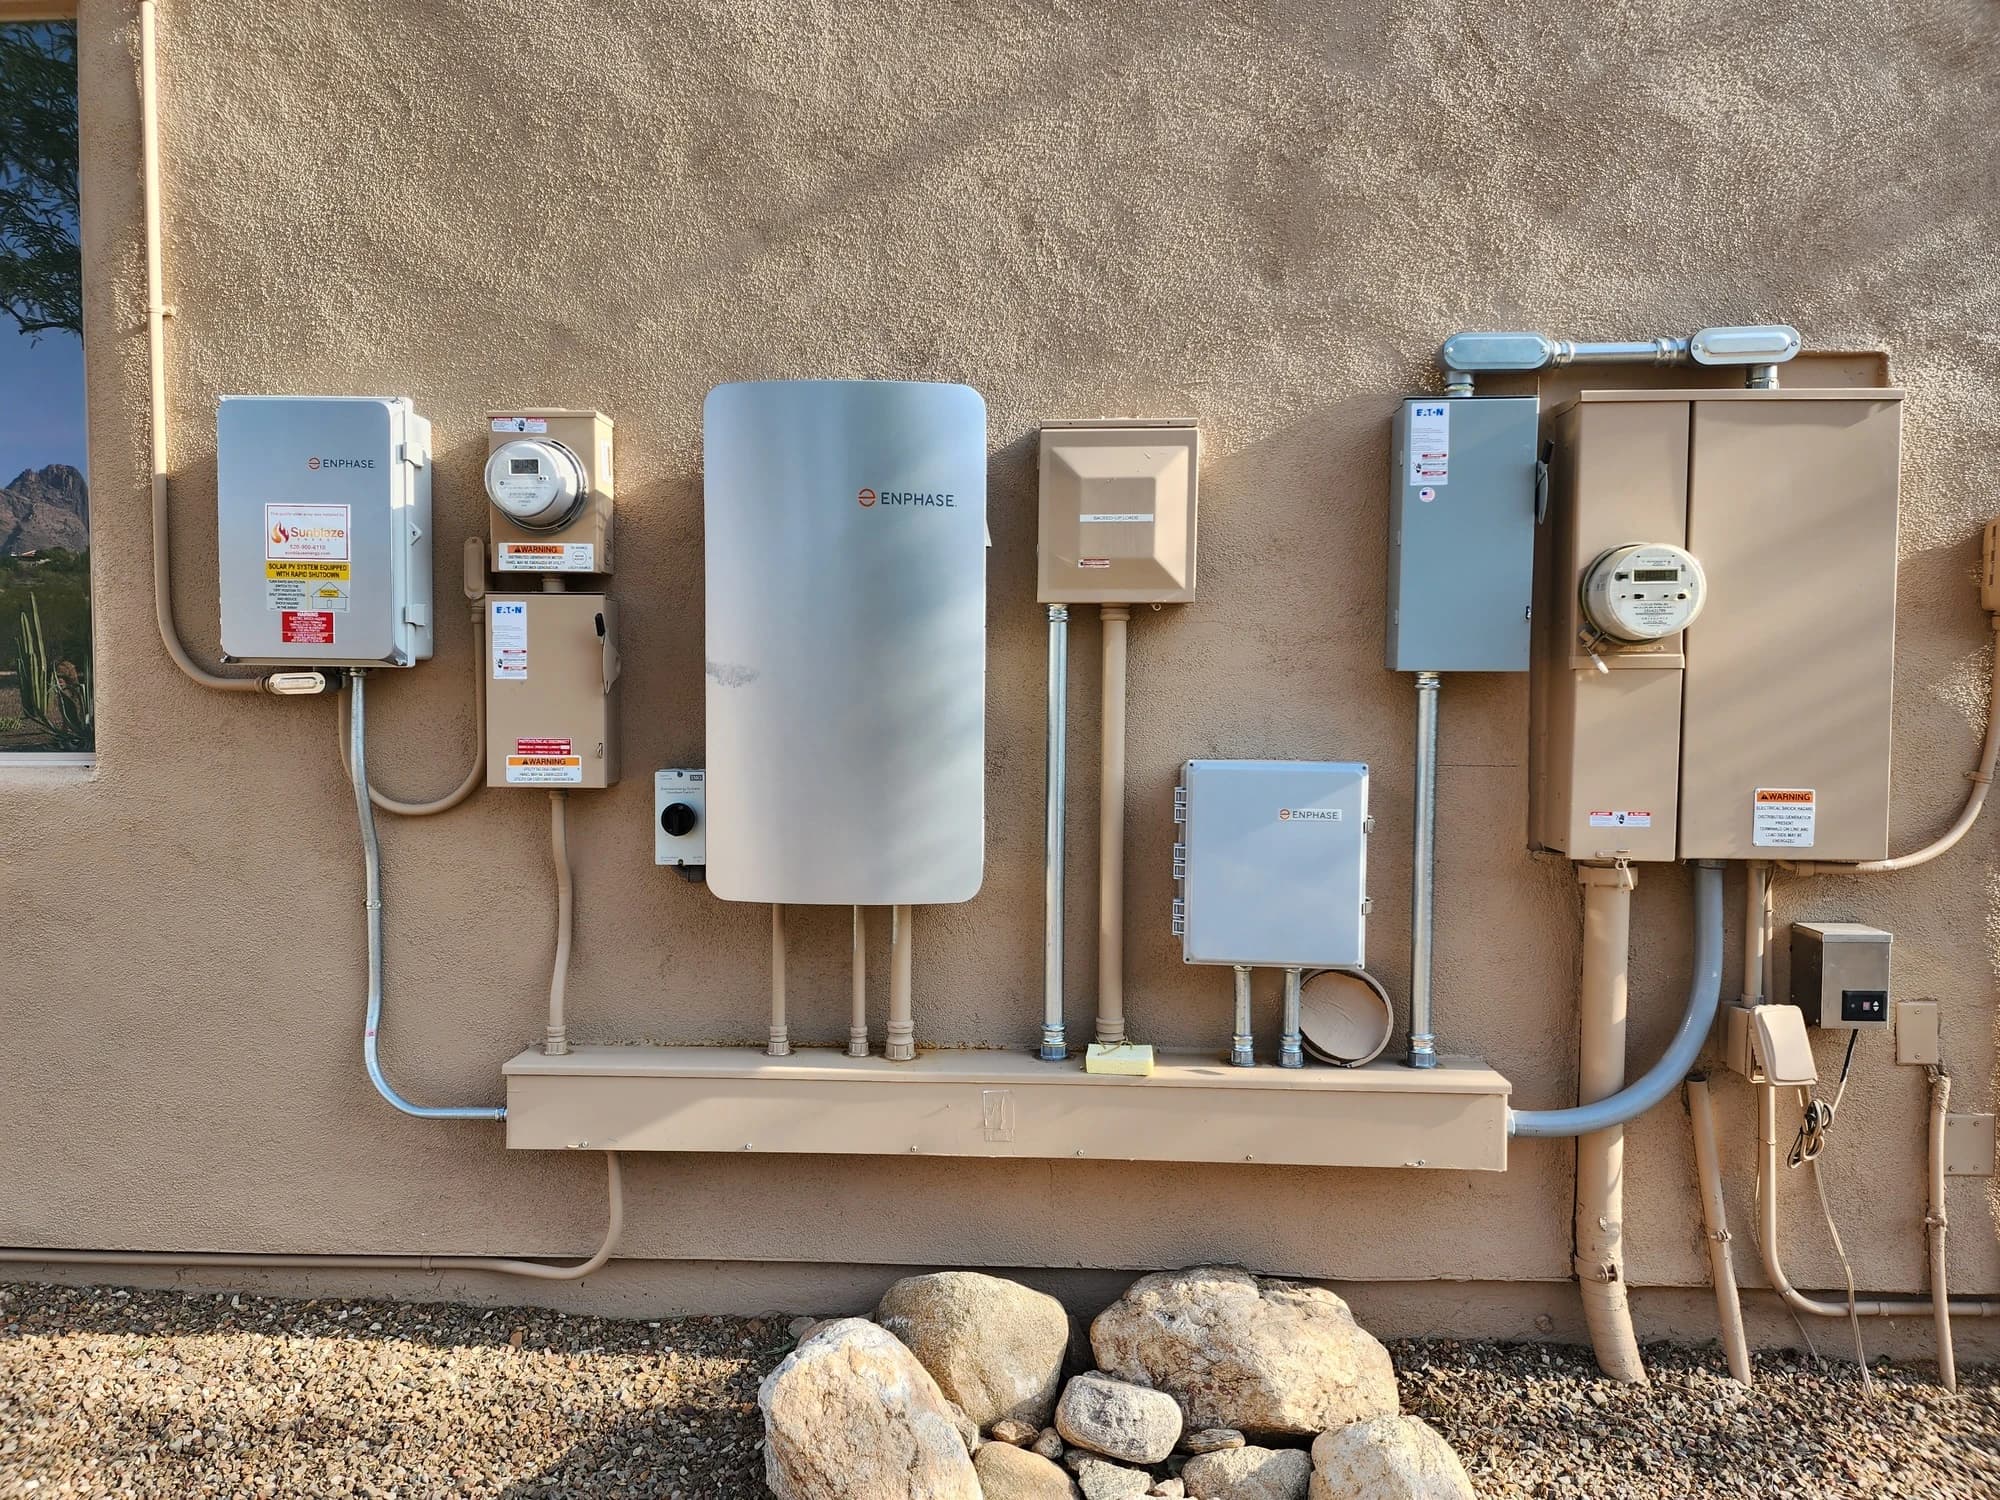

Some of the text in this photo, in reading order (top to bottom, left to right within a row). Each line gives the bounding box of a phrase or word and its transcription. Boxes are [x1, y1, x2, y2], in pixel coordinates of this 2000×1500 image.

[322, 459, 374, 469] ENPHASE
[881, 492, 954, 507] ENPHASE
[290, 526, 345, 538] Sunblaze
[520, 545, 558, 553] WARNING
[528, 758, 567, 766] WARNING
[1769, 793, 1811, 801] WARNING
[1292, 810, 1338, 820] ENPHASE
